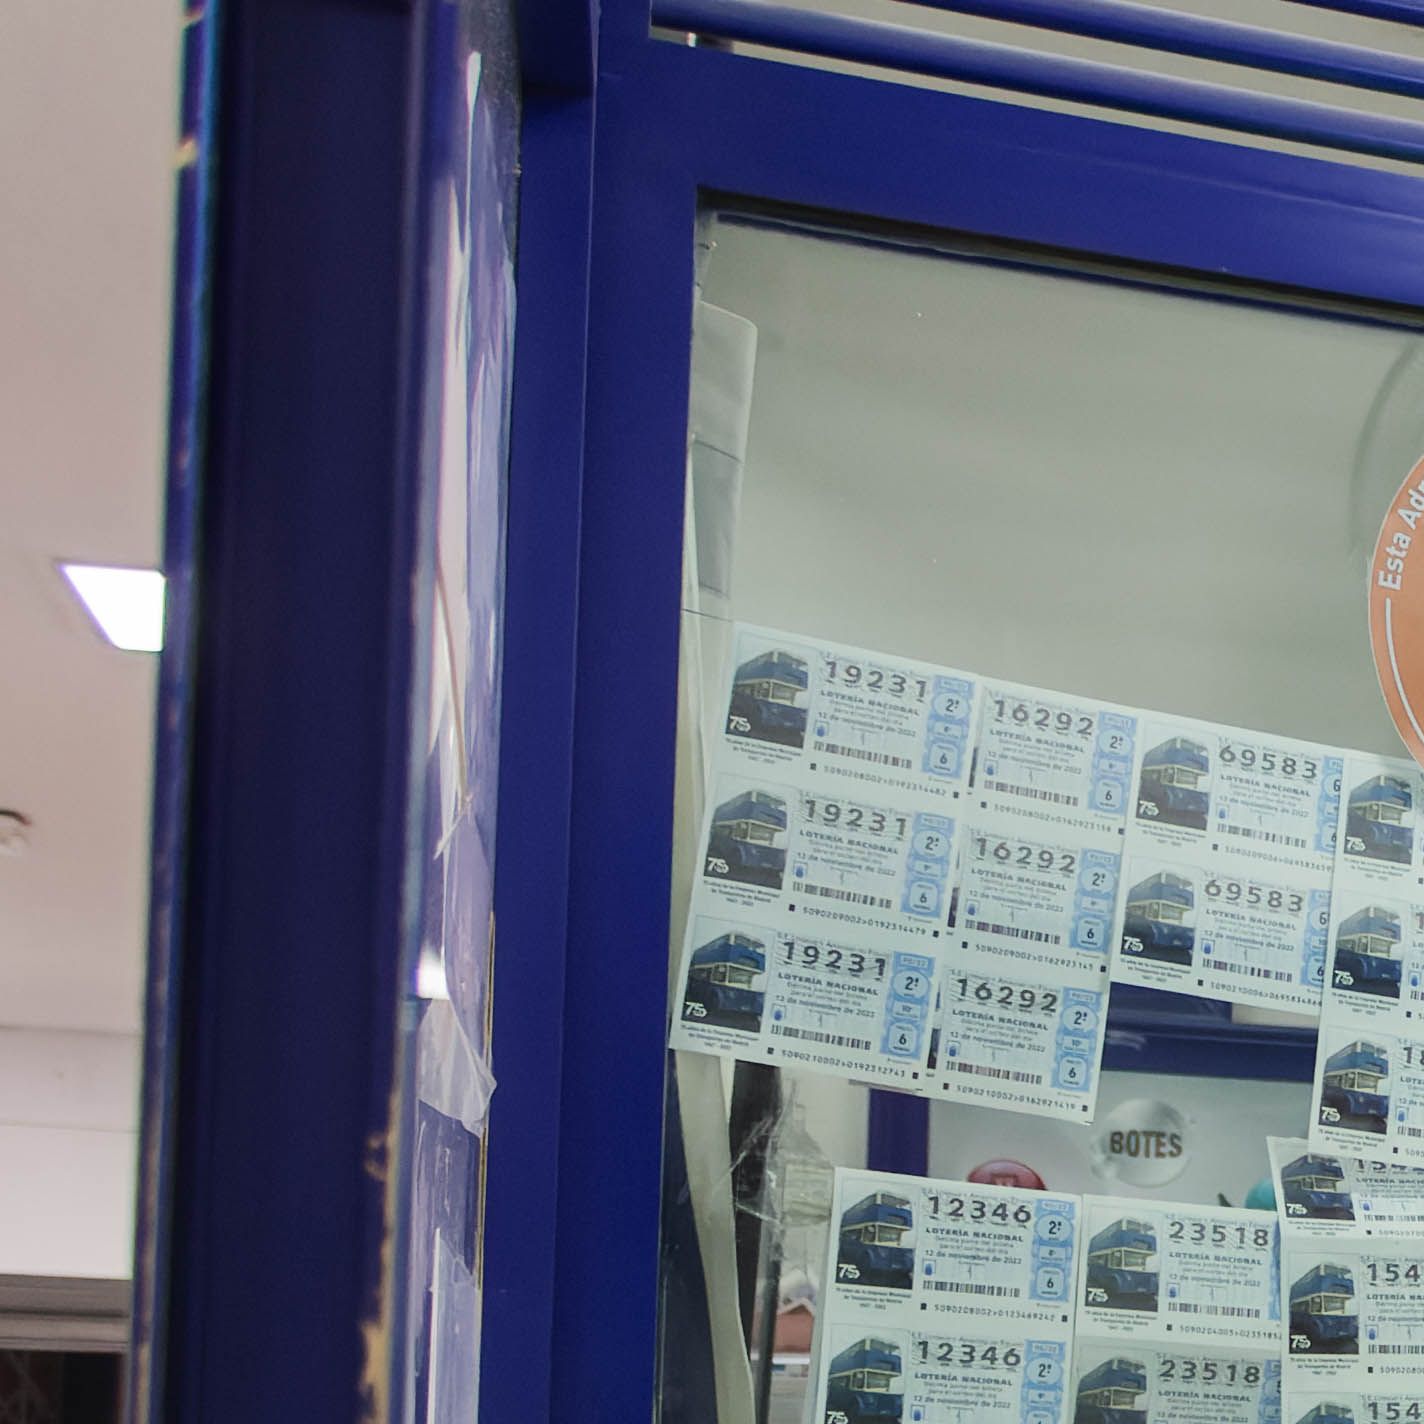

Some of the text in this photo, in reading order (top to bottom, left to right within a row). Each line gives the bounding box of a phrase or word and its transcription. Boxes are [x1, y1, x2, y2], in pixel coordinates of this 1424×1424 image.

[1378, 532, 1411, 590] Esta
[825, 660, 929, 700] 19231
[1218, 744, 1319, 780] 69583
[1110, 1129, 1184, 1160] BOTES
[926, 1195, 1033, 1225] 12346
[1168, 1220, 1270, 1248] 23518
